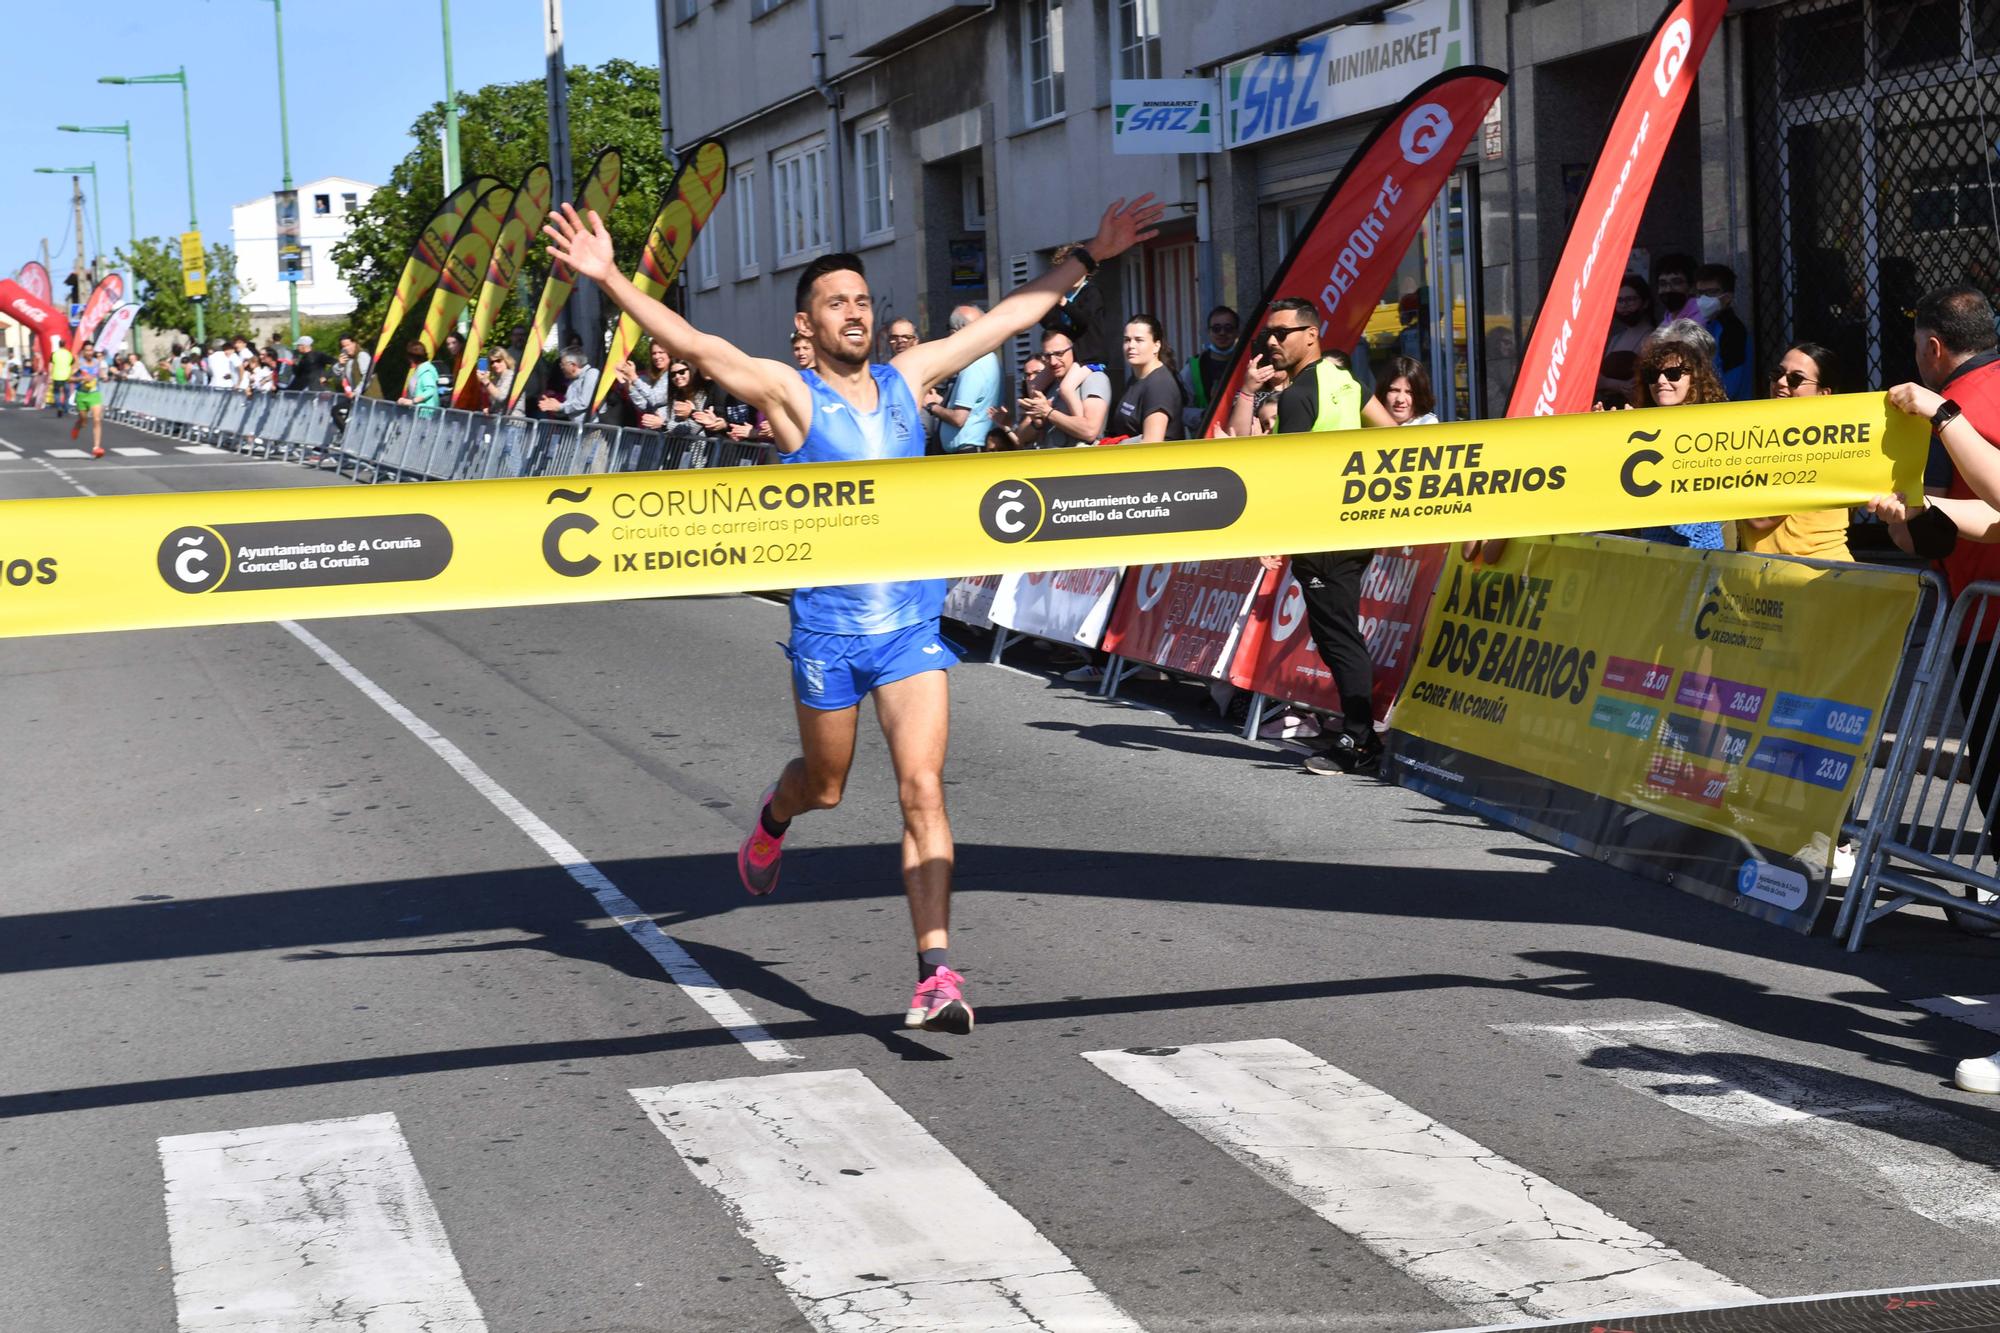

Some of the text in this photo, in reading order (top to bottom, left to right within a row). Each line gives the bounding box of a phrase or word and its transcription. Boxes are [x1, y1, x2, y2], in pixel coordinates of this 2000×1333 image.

[1327, 26, 1441, 87] MINIMARKET
[1142, 100, 1199, 108] MINIMARKET
[1127, 107, 1196, 132] SAZ
[1320, 173, 1404, 314] DEPORTE
[1673, 422, 1872, 455] CORUÑACORRE
[1340, 442, 1485, 477] A XENTE
[1725, 455, 1742, 467] de
[1745, 451, 1803, 466] carreiras
[1805, 448, 1872, 465] populares
[1341, 465, 1568, 505] DOS BARRIOS
[1670, 469, 1818, 494] IX EDICIÓN 2022
[611, 479, 876, 519] CORUÑACORRE
[1051, 488, 1219, 511] Ayuntamiento de A Coruña
[1339, 500, 1473, 522] CORRE NA CORUÑA
[684, 523, 707, 537] de
[711, 517, 789, 535] carreiras
[793, 512, 880, 534] populares
[1051, 506, 1170, 525] Concello da Coruña
[237, 536, 422, 561] Ayuntamiento de A Coruña
[613, 541, 813, 573] IX EDICIÓN 2022
[238, 554, 370, 574] Concello da Coruña
[1360, 545, 1420, 605] RUÑA
[1443, 564, 1553, 632] A XENTE
[1427, 620, 1597, 705] DOS BARRIOS
[1411, 681, 1452, 709] CORRE
[1463, 696, 1509, 725] CORUÑA
[1729, 691, 1761, 714] 26.03
[1826, 710, 1865, 736] 08.05
[1815, 757, 1848, 781] 23.10
